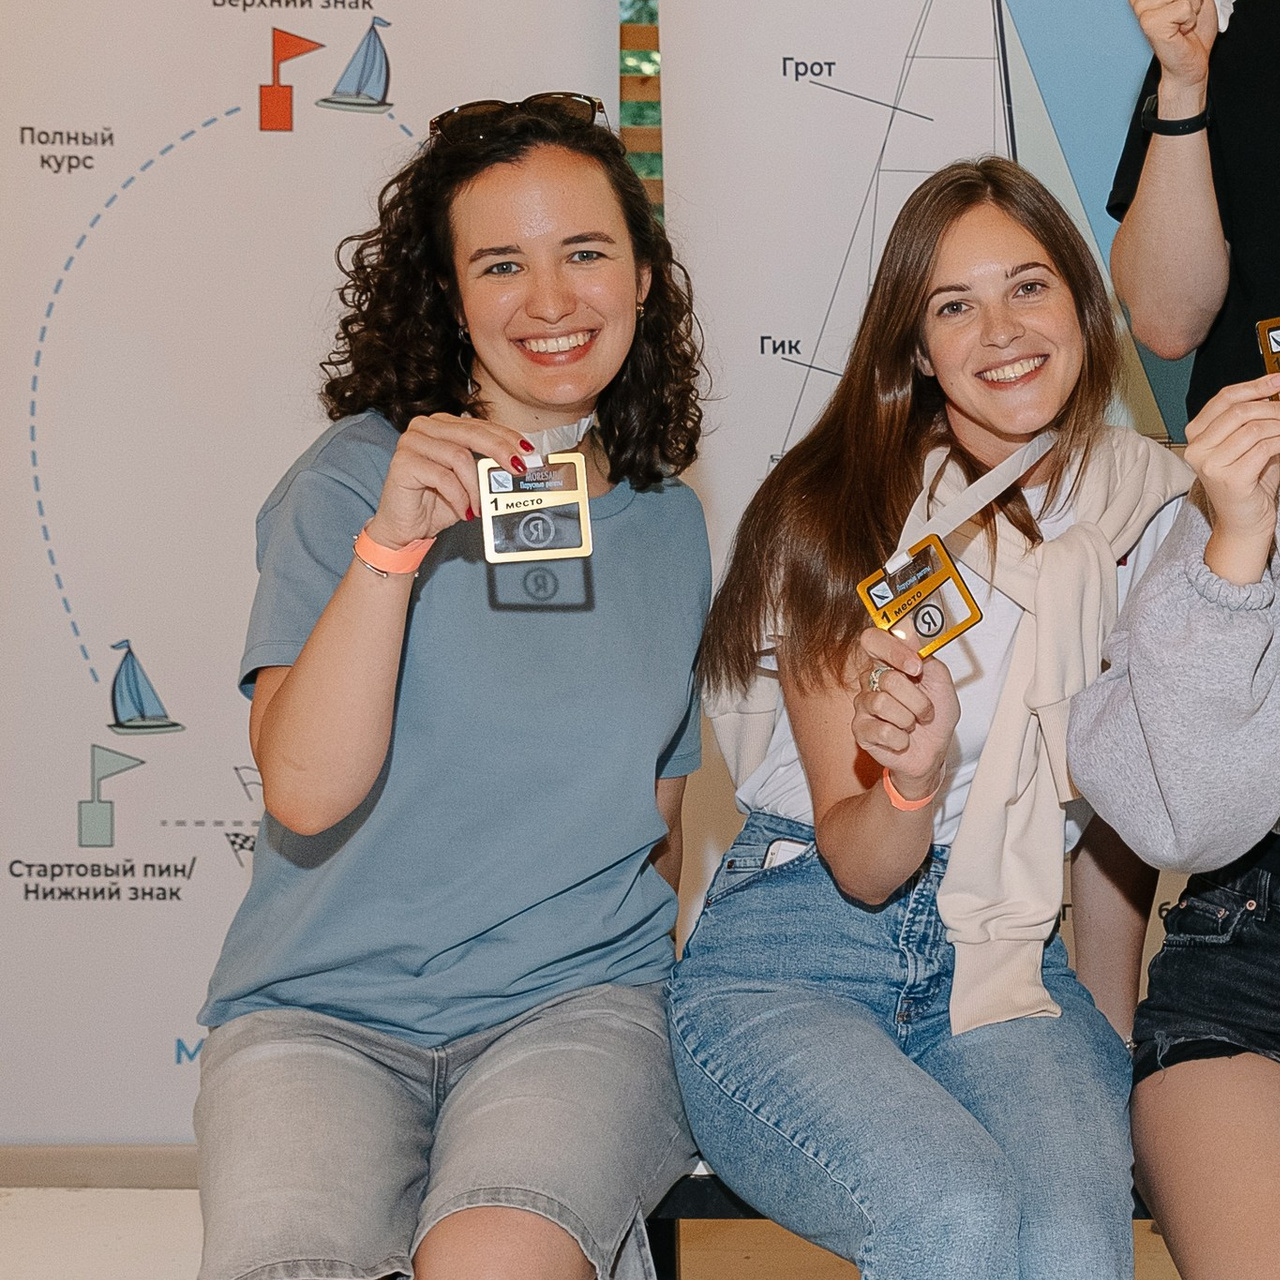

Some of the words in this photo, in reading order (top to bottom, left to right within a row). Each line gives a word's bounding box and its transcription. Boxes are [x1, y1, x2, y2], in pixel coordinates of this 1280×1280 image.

[782, 56, 836, 82] Грот
[20, 125, 115, 147] Полный
[40, 154, 95, 174] курс
[760, 336, 801, 355] Гик
[1273, 357, 1280, 371] 1
[490, 497, 499, 511] 1
[505, 497, 543, 510] место
[881, 610, 892, 624] 1
[893, 590, 923, 617] место
[9, 858, 135, 881] Стартовый
[143, 856, 197, 880] пин/
[24, 881, 121, 901] Нижний
[128, 885, 182, 901] знак
